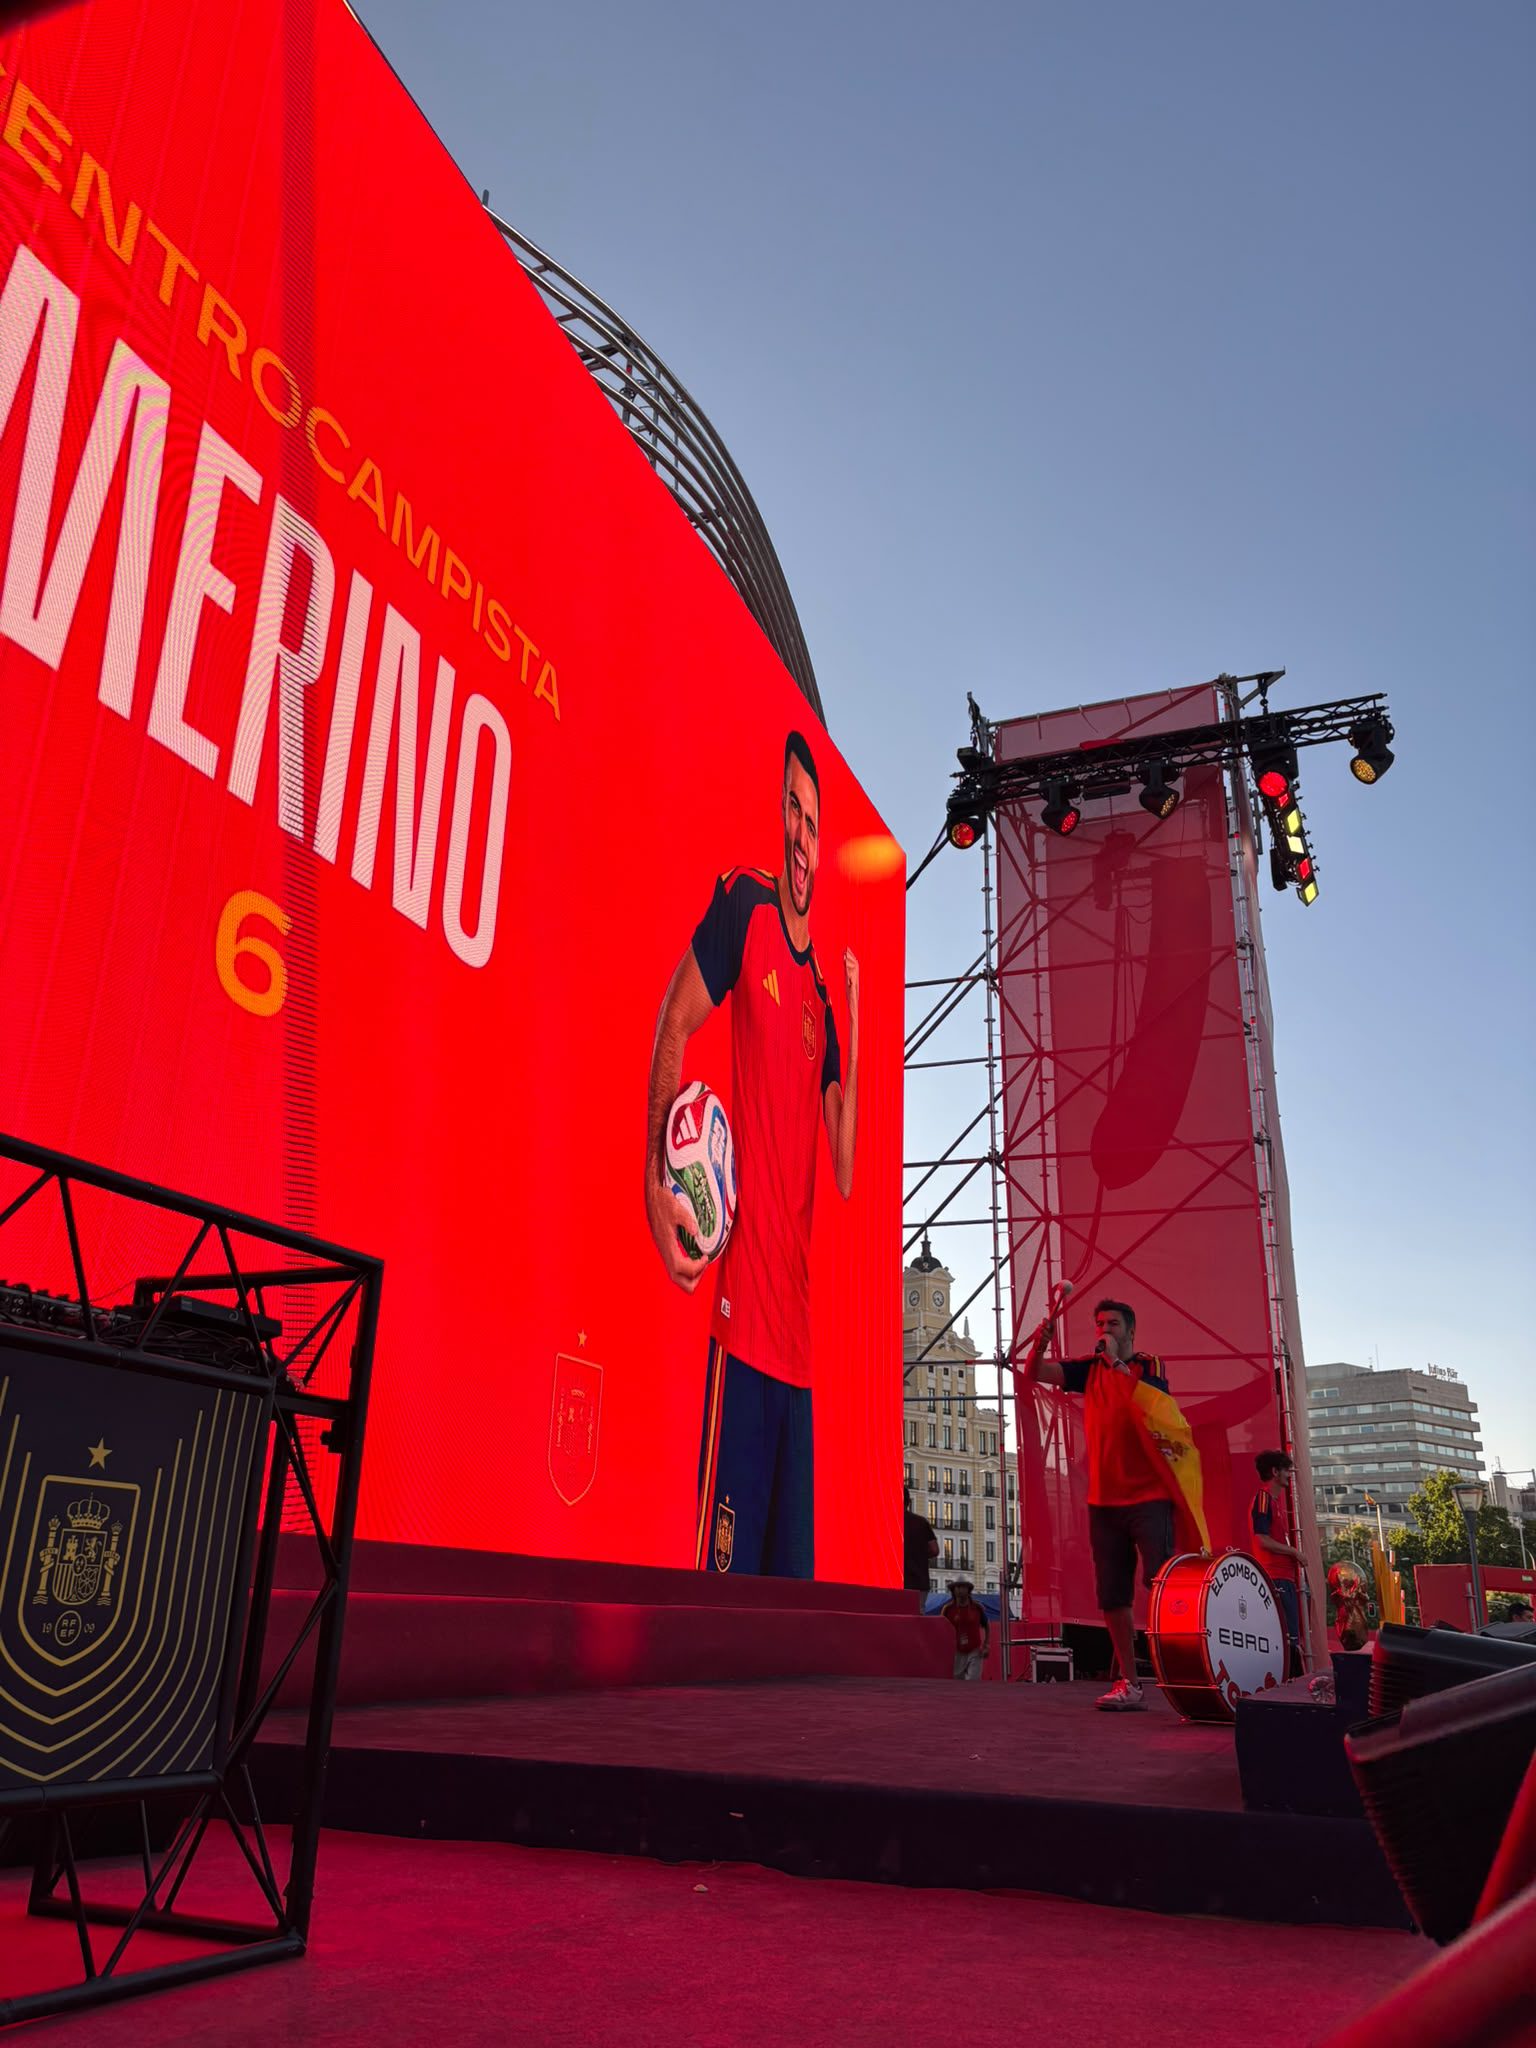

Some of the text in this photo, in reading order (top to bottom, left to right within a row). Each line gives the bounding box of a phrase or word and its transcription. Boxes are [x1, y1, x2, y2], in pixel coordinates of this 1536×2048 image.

[0, 61, 561, 722] ENTROCAMPISTA
[0, 243, 512, 969] MERINO
[215, 890, 293, 1017] 6
[84, 1623, 96, 1634] 09
[1211, 1562, 1272, 1610] EL BOMBO DE
[1218, 1627, 1270, 1654] EBRO
